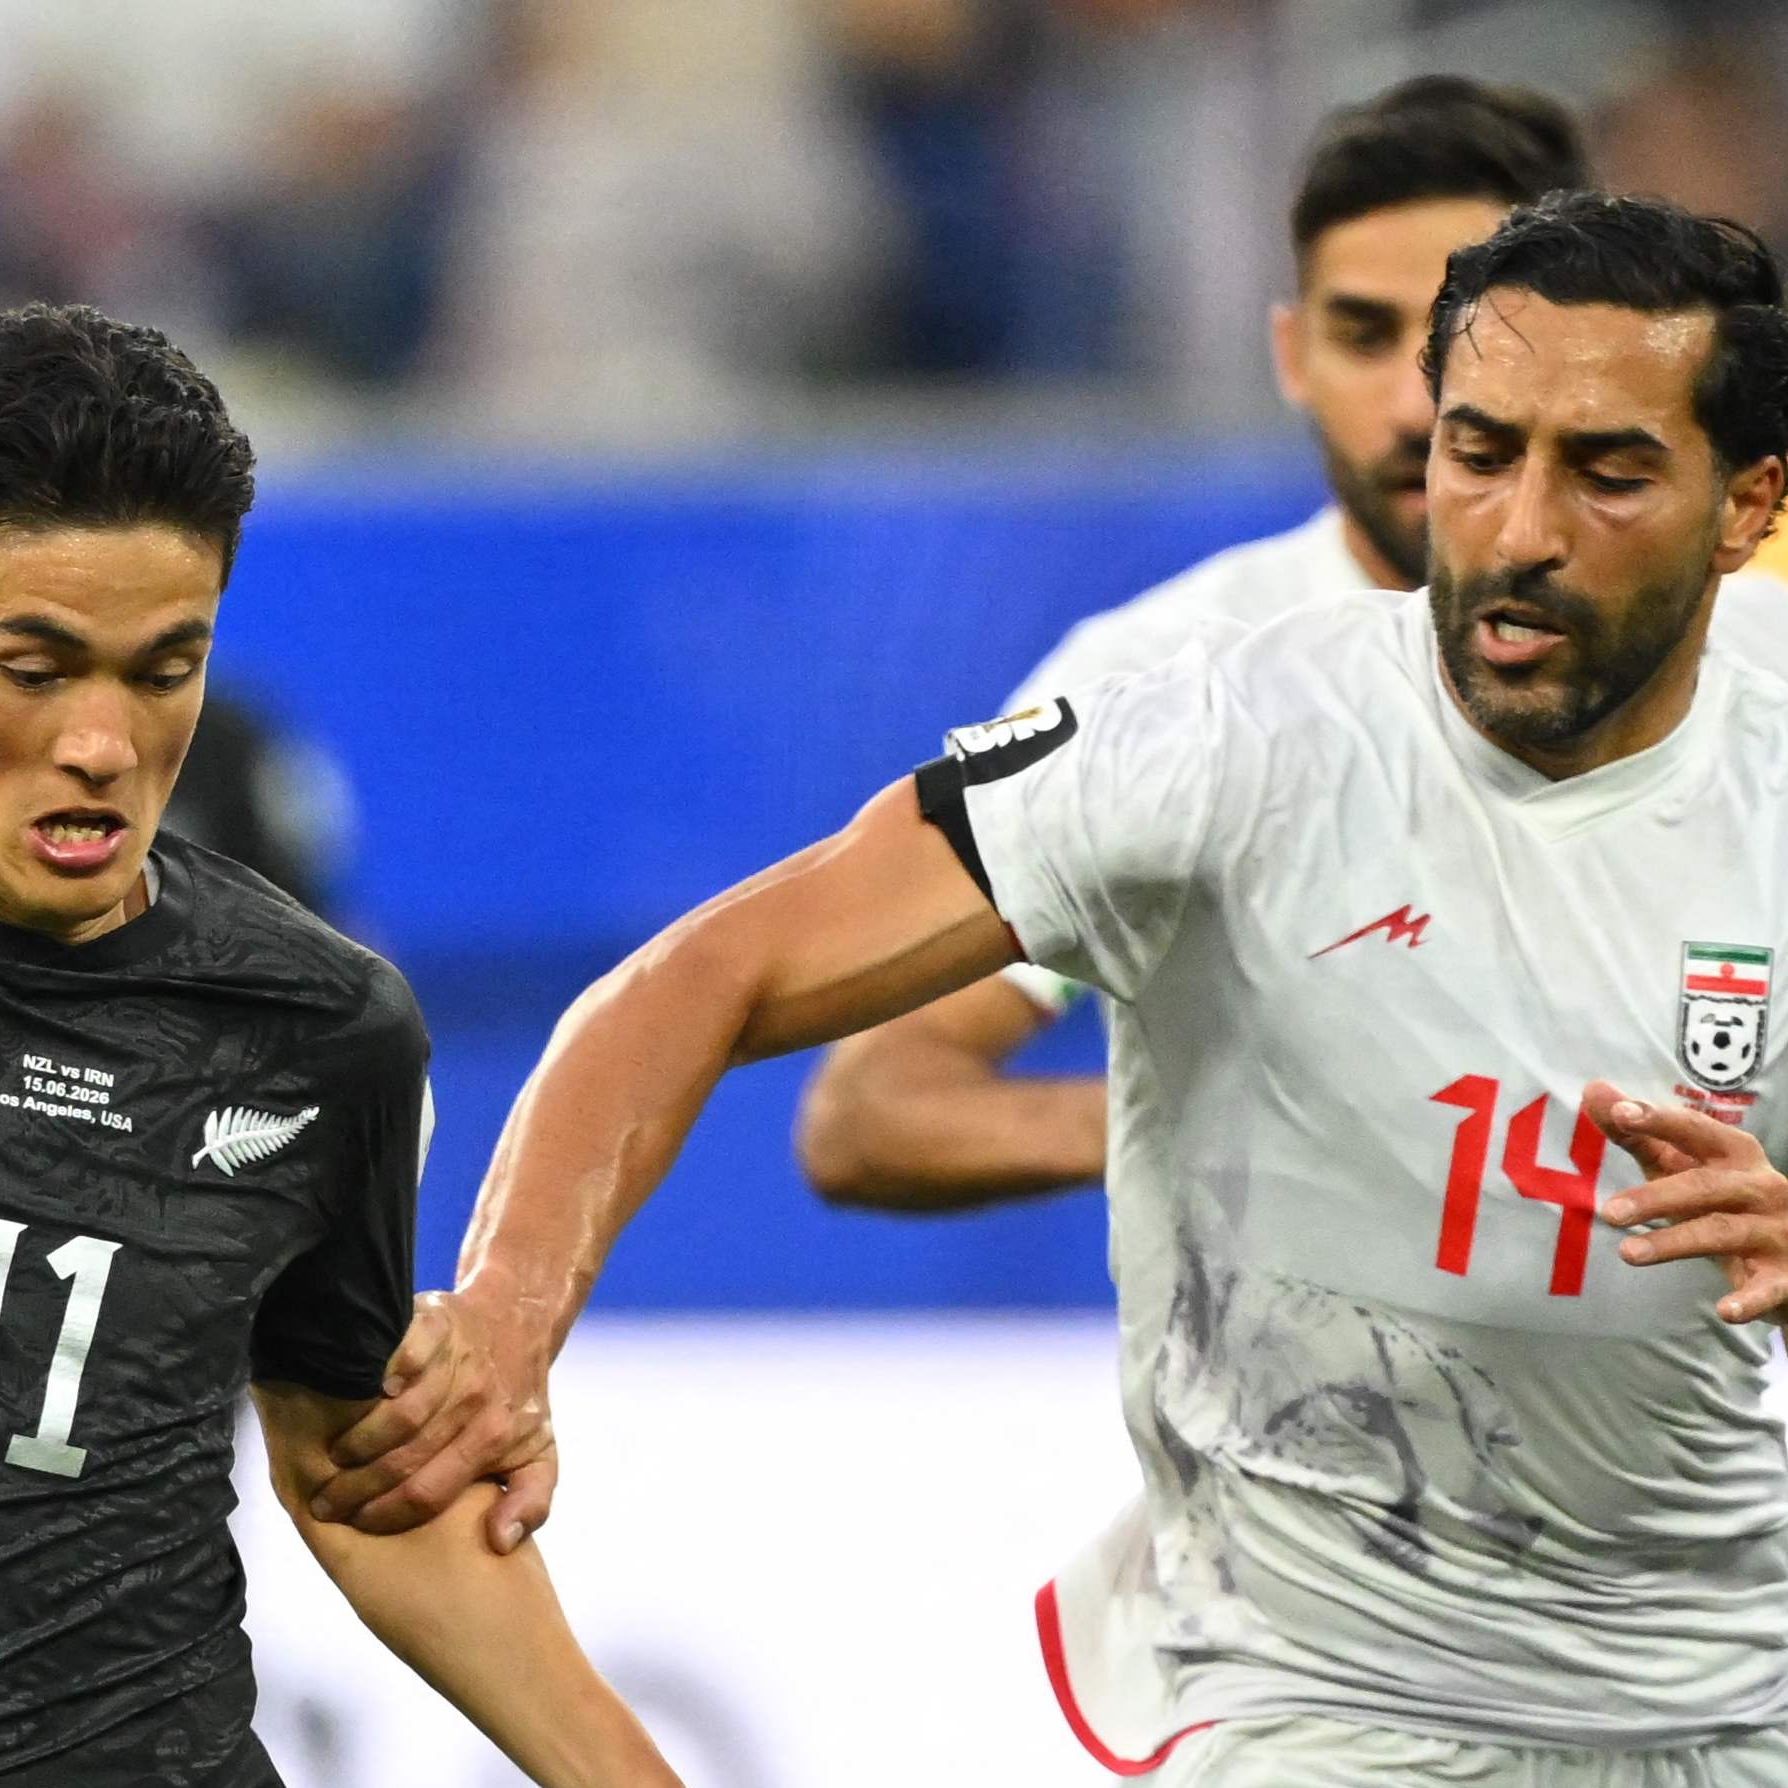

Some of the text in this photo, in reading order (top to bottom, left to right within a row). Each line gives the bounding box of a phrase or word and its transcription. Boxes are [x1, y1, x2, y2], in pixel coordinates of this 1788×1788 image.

[22, 1053, 114, 1088] NZL vs IRN
[23, 1075, 110, 1105] 15.06.2026
[22, 1096, 96, 1124] Angeles,
[100, 1110, 133, 1133] USA
[1427, 1073, 1610, 1298] 14
